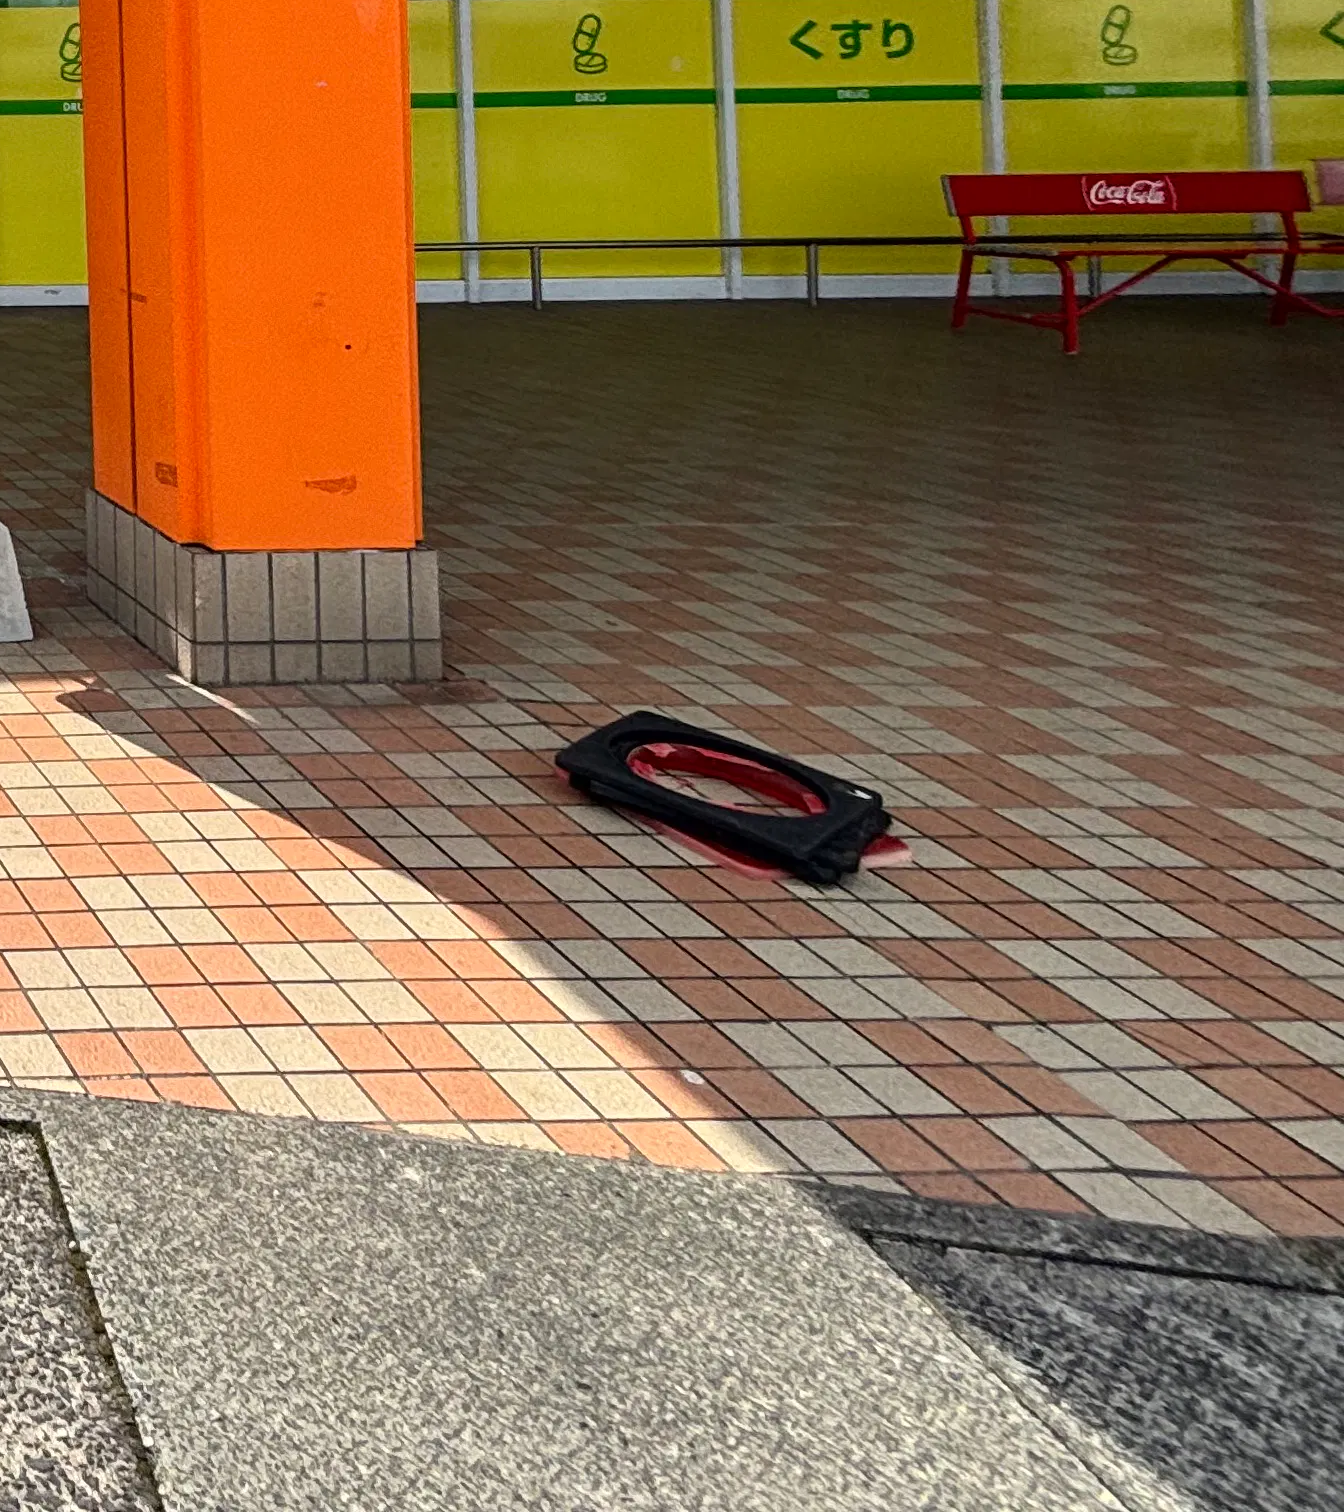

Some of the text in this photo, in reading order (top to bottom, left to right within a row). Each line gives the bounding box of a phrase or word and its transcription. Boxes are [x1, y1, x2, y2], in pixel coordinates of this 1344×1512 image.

[788, 18, 915, 60] くすり
[575, 92, 607, 102] DRUG
